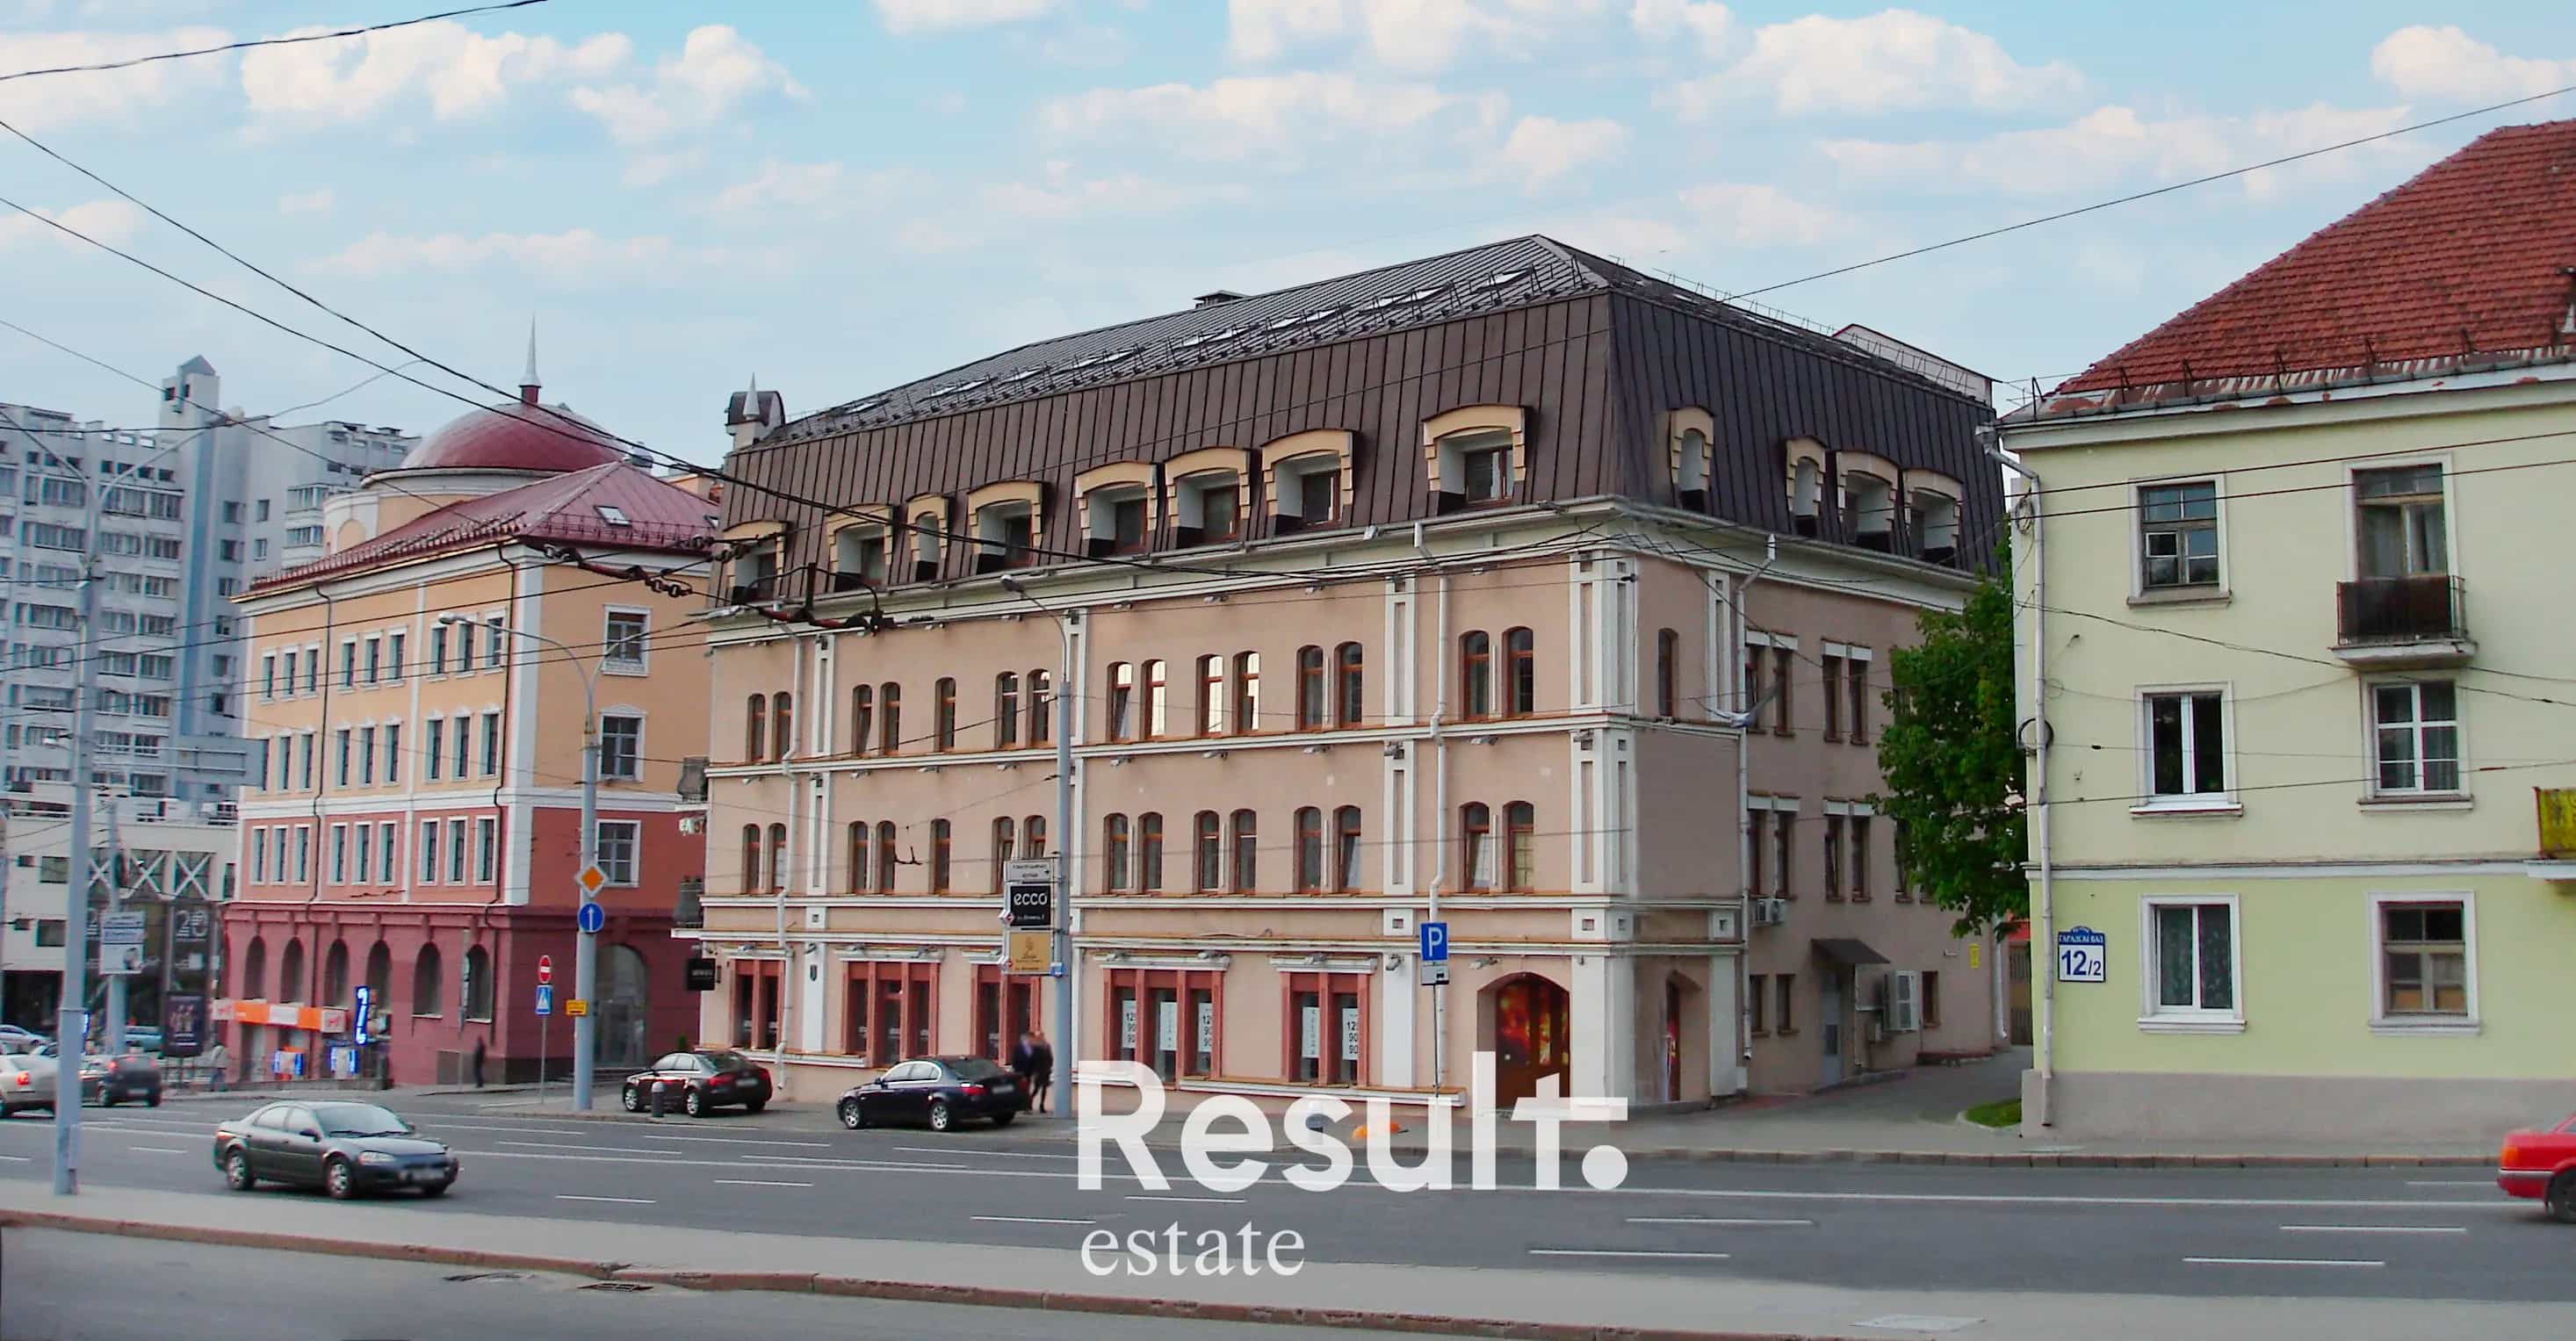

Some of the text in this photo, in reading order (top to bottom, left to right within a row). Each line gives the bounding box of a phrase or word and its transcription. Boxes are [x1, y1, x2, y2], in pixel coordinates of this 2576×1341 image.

[1014, 892, 1048, 905] ecco
[1428, 926, 1443, 957] P
[2061, 949, 2102, 977] 12/2
